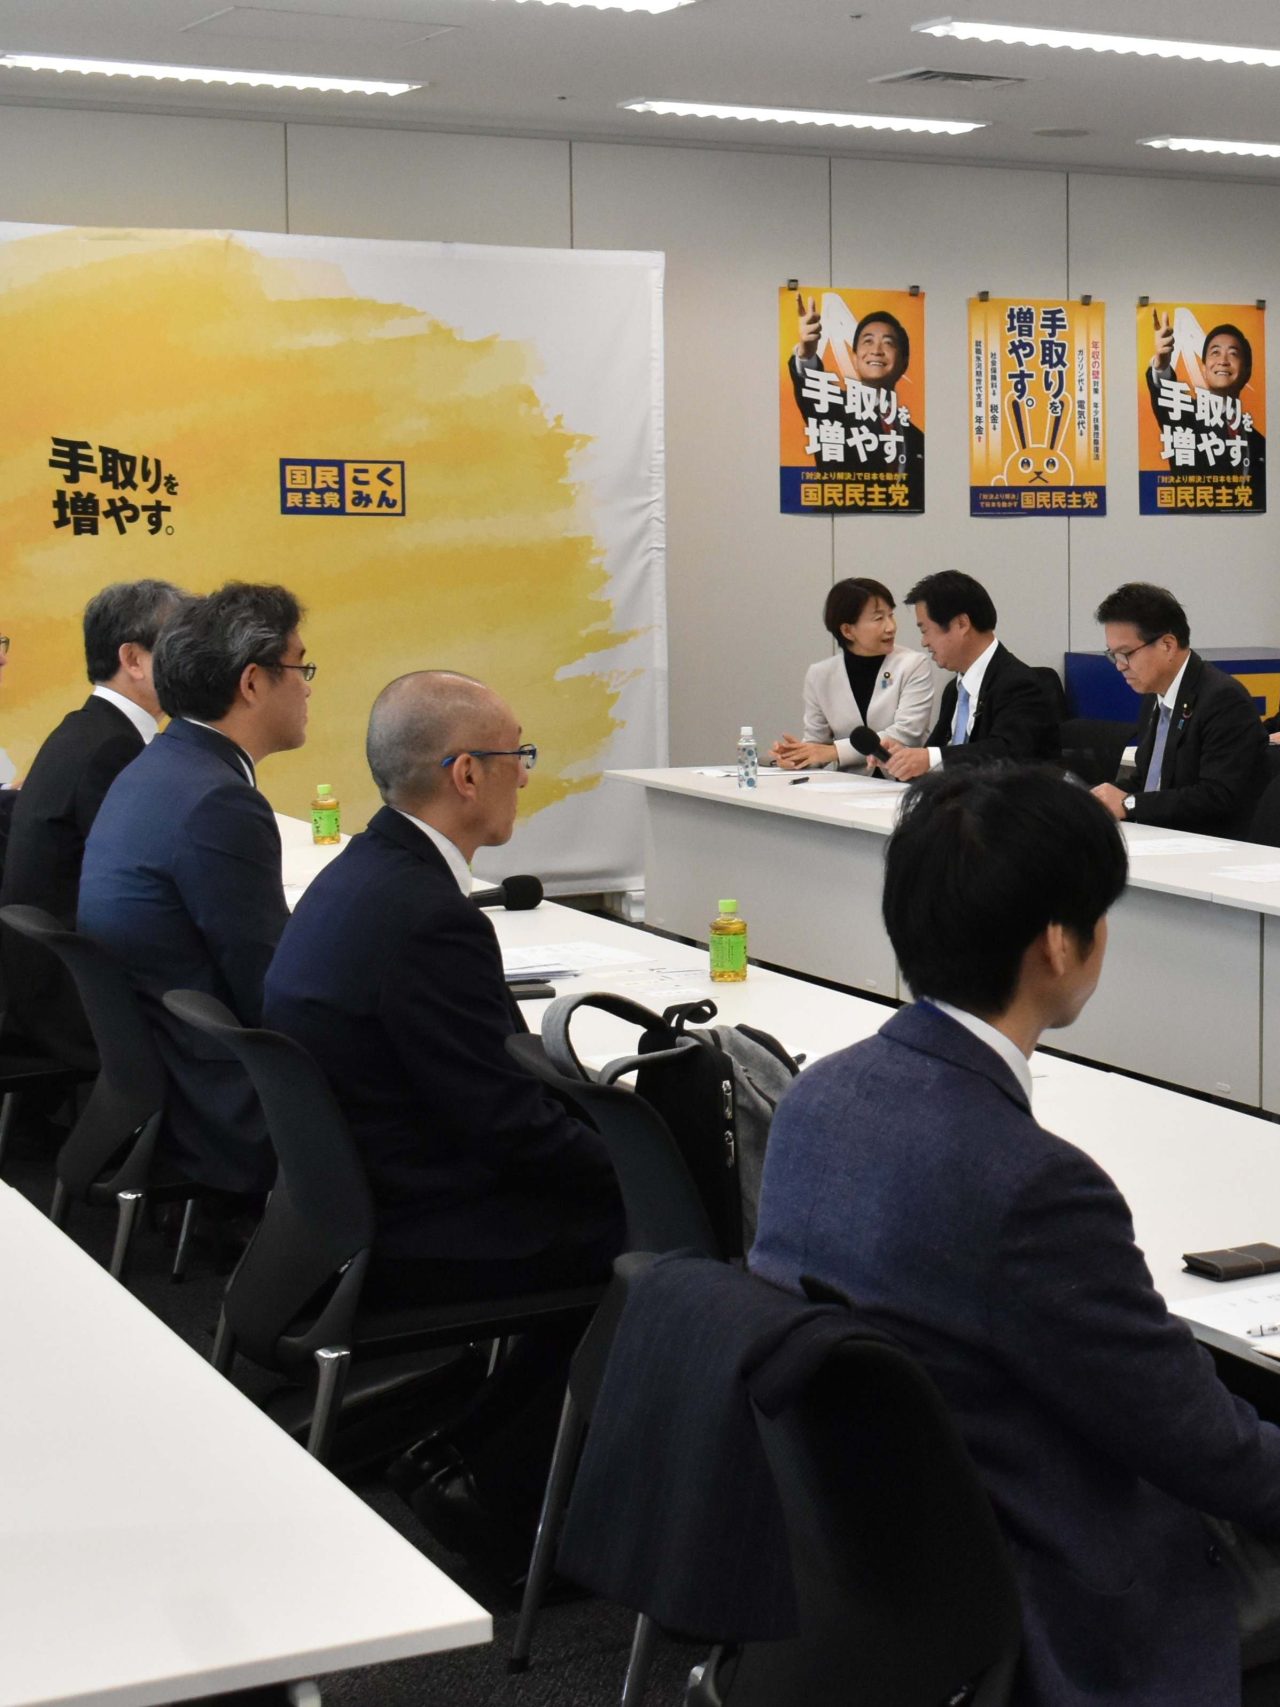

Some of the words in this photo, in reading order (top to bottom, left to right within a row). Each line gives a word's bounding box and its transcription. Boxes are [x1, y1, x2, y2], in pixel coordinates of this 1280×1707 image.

[1007, 307, 1035, 407] 増やす。
[1040, 307, 1067, 415] 手取りを
[801, 368, 911, 427] 手取りを
[1157, 378, 1254, 432] 手取りを
[975, 415, 984, 435] 年金
[990, 404, 999, 424] 税金
[1077, 400, 1086, 431] 電気代
[804, 417, 907, 464] 増やす。
[1160, 424, 1251, 467] 増やす。
[48, 436, 180, 496] 手取りを
[285, 465, 340, 489] 国民
[352, 466, 394, 487] こく
[286, 491, 341, 508] 民主党
[351, 490, 398, 509] みん
[800, 483, 910, 507] 国民民主党
[1021, 491, 1098, 509] 国民民主党
[1156, 486, 1253, 508] 国民民主党
[52, 489, 175, 536] 増やす。
